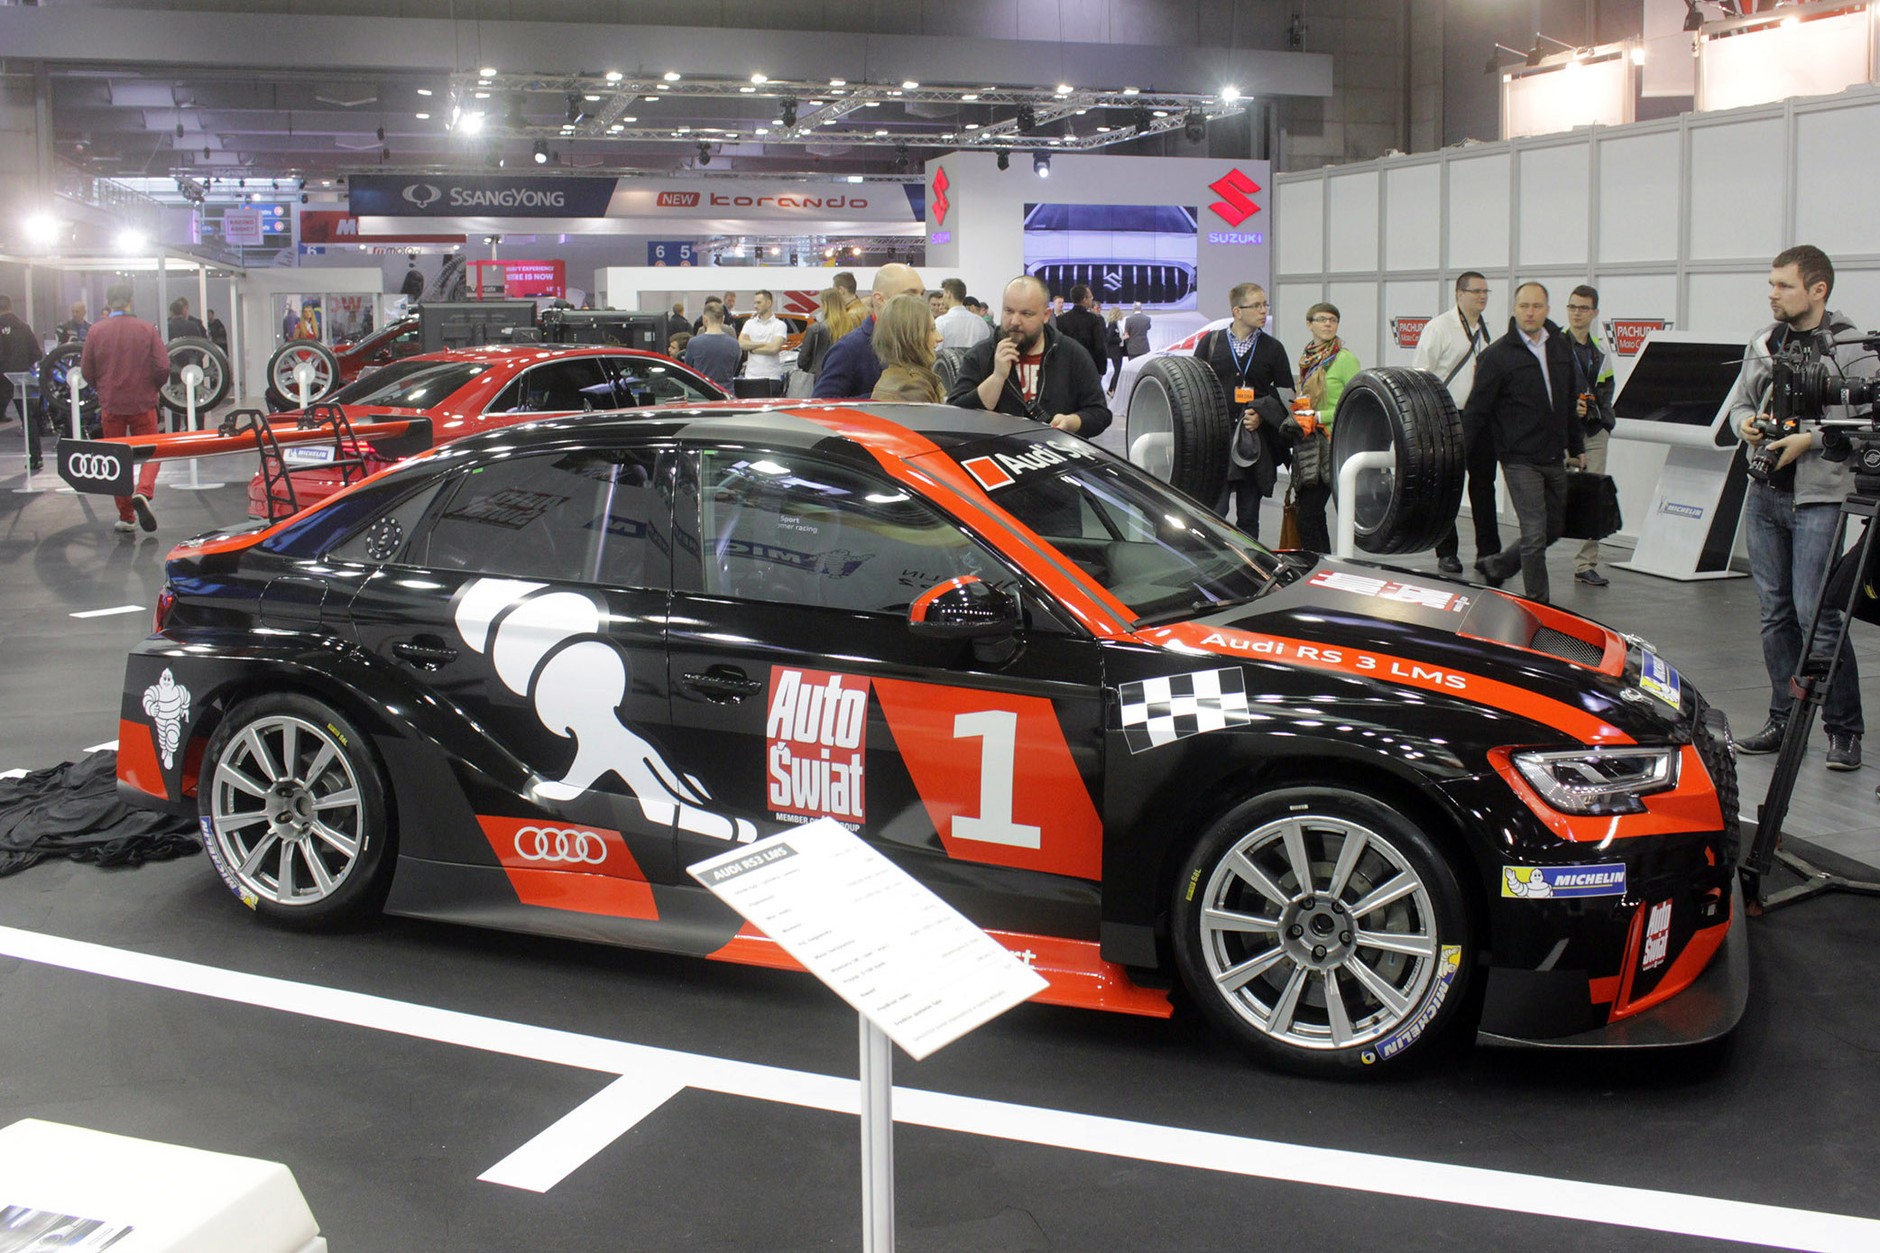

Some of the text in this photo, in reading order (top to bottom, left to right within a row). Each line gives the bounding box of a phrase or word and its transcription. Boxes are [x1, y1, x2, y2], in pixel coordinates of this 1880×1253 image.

[662, 194, 694, 205] NEW
[1208, 232, 1262, 244] SUZUKI
[655, 245, 665, 258] 6
[680, 245, 690, 258] 5
[995, 444, 1068, 475] Audi
[1667, 504, 1701, 516] MICHELIN
[780, 515, 800, 524] Sport
[795, 524, 818, 534] racing
[1201, 633, 1467, 689] Audi RS 3 LMS
[767, 670, 867, 749] Auto
[769, 741, 863, 818] Świat
[953, 709, 1041, 850] 1
[776, 812, 808, 825] MEMBER
[713, 846, 788, 881] AUDI RS3 LMS
[1554, 871, 1625, 886] MICHELIN
[1384, 980, 1450, 1057] MICHELIN
